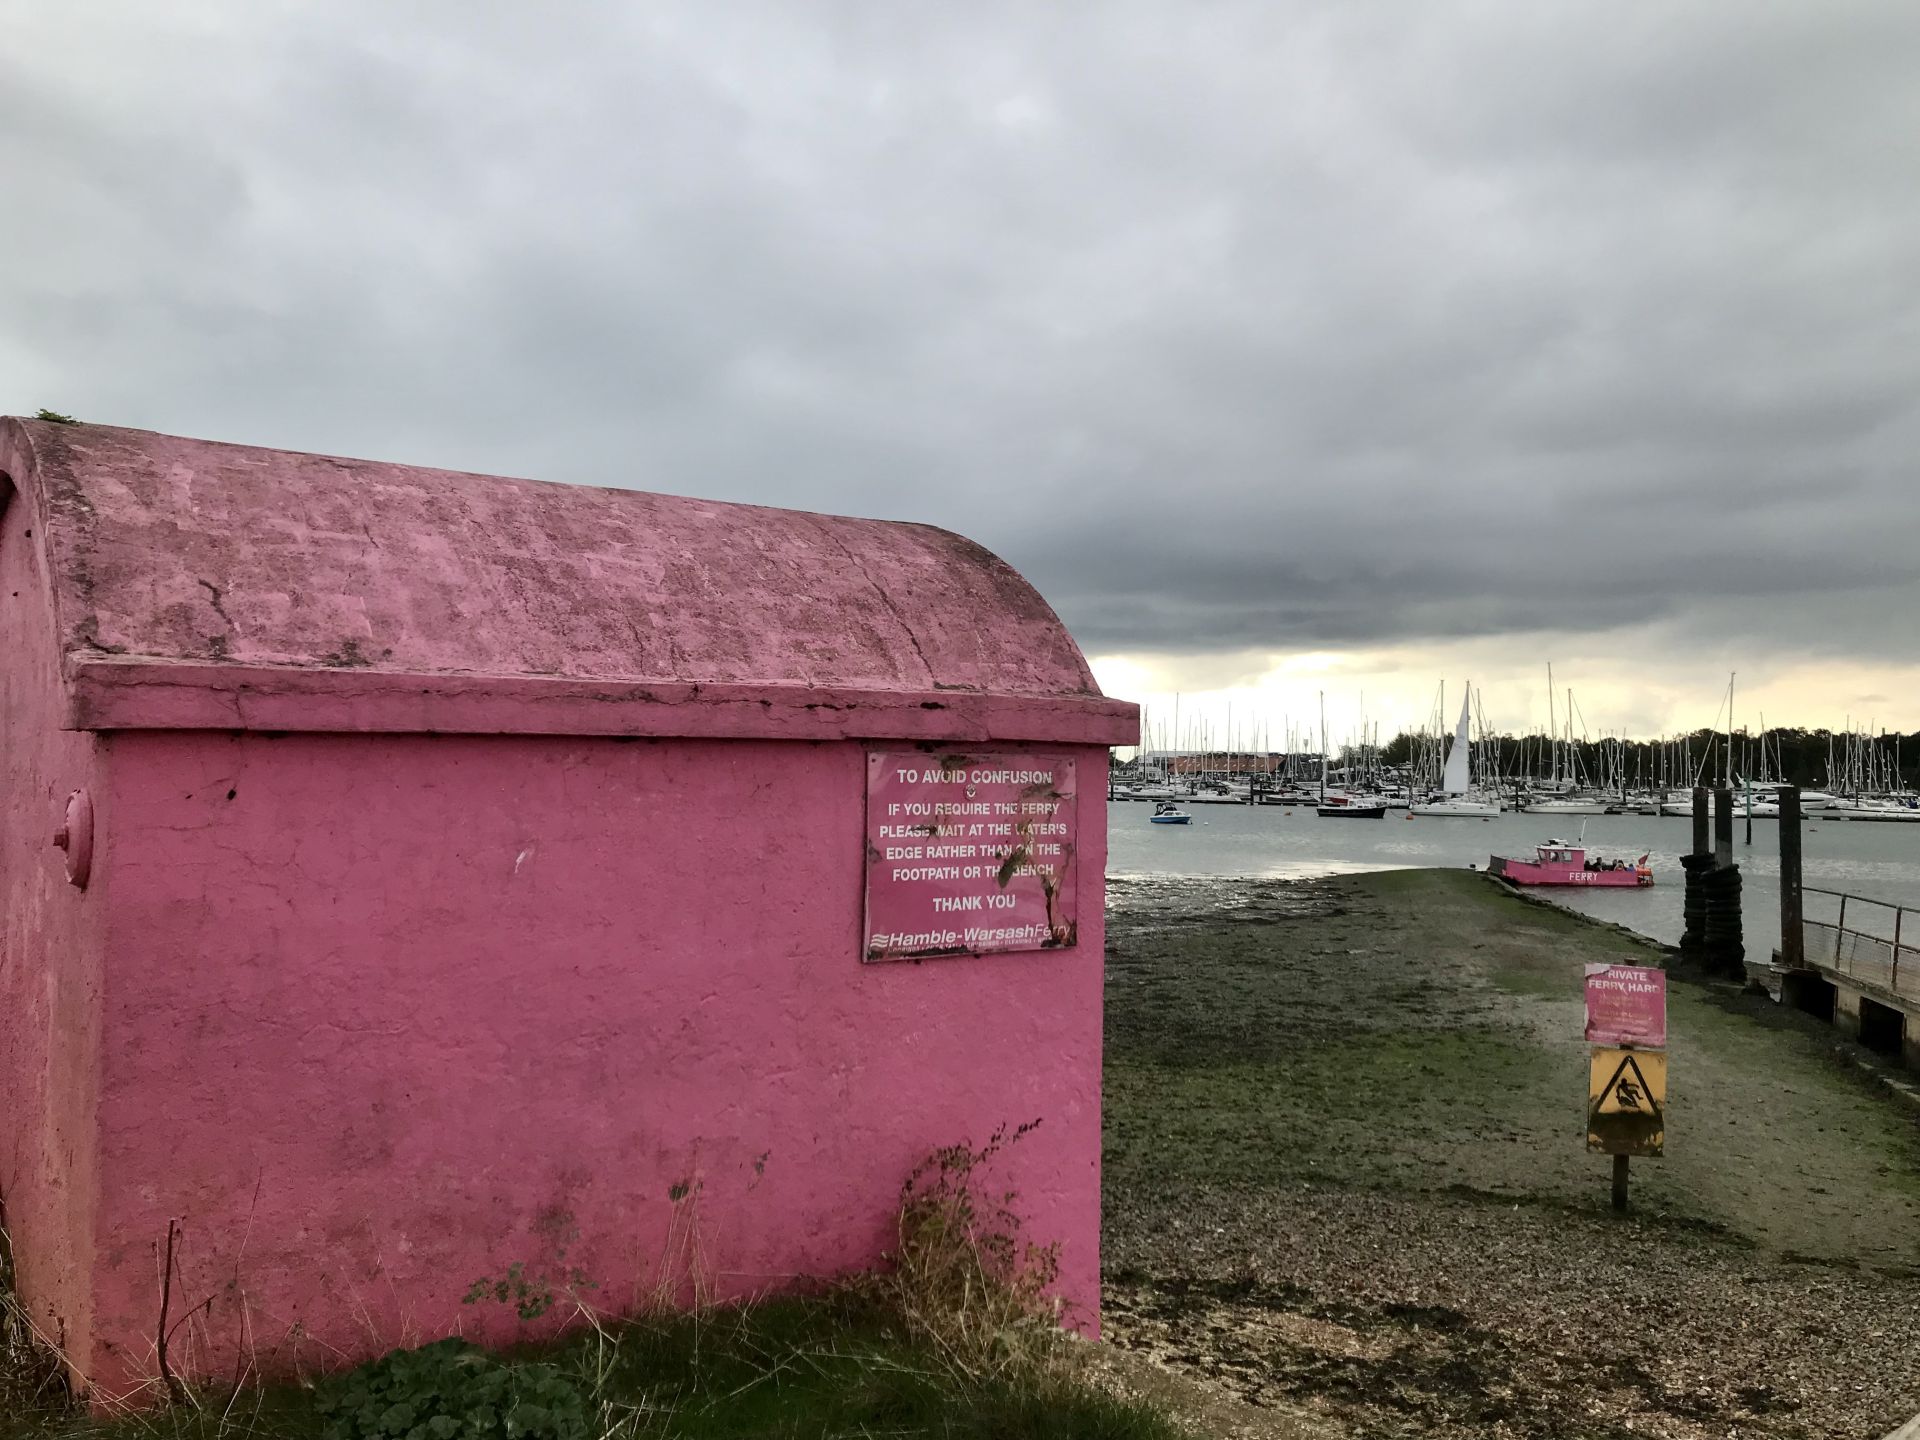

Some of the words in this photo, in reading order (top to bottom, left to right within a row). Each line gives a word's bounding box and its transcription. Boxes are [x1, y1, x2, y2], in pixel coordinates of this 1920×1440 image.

[897, 769, 918, 783] TO
[922, 769, 967, 784] AVOID
[971, 770, 1053, 784] CONFUSION
[888, 803, 900, 816] IF
[904, 803, 931, 816] YOU
[935, 803, 991, 815] REQUIRE
[994, 803, 1018, 815] THE
[1021, 803, 1060, 815] FERRY
[879, 824, 931, 838] PLEASE
[934, 823, 965, 837] WAIT
[968, 823, 985, 836] AT
[987, 823, 1012, 836] THE
[886, 846, 922, 860] EDGE
[926, 845, 976, 859] RATHER
[979, 844, 1012, 857] THAN
[1037, 843, 1061, 855] THE
[892, 866, 960, 882] FOOTPATH
[963, 865, 981, 879] OR
[984, 864, 1004, 878] TH
[1012, 863, 1054, 877] BENCH
[1569, 872, 1598, 881] FERRY
[933, 896, 983, 912] THANK
[986, 894, 1016, 910] YOU
[1608, 970, 1647, 981] RIVATE
[1588, 980, 1624, 990] FERRY
[1628, 984, 1660, 993] HARD
